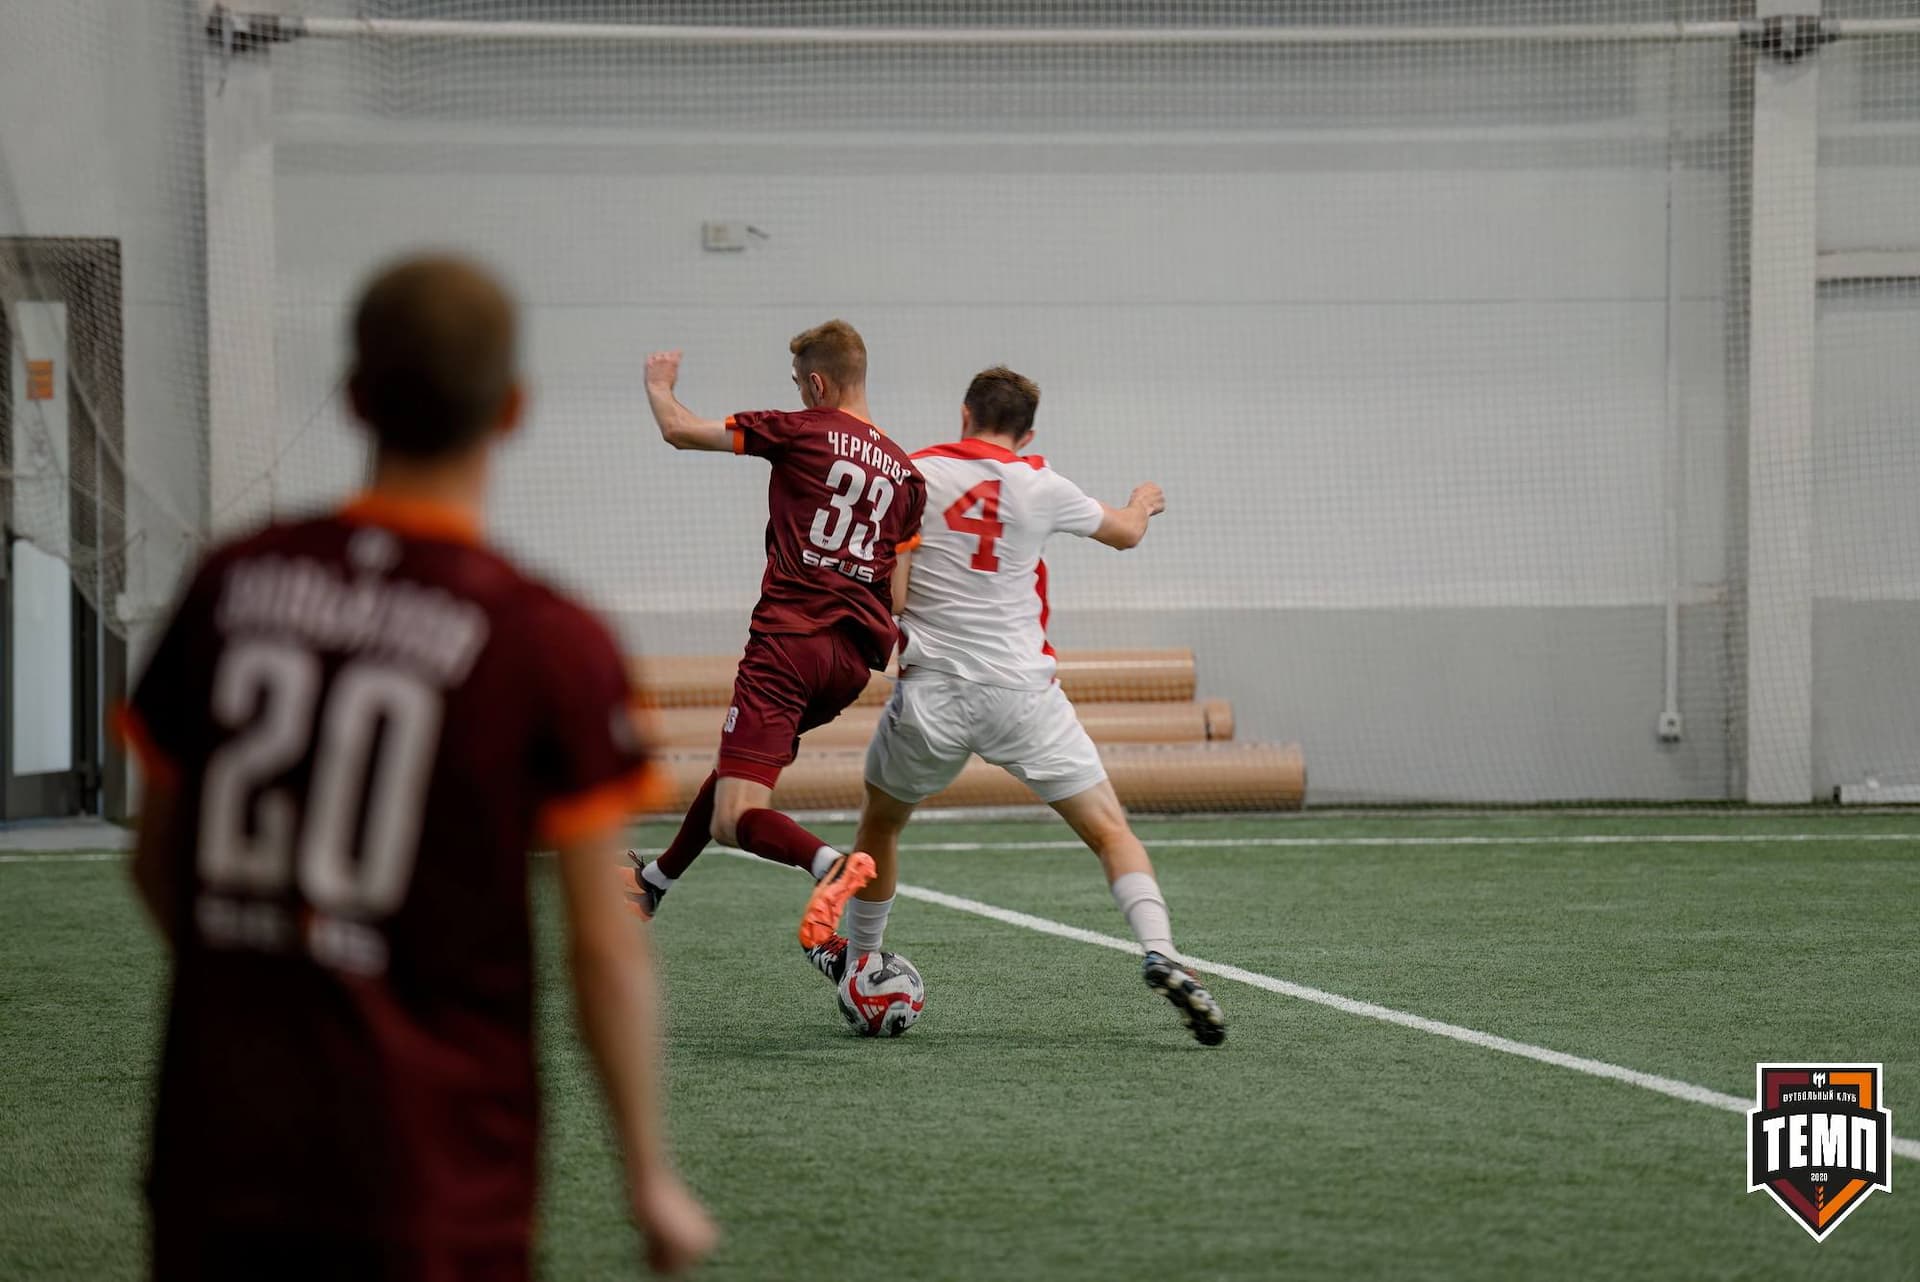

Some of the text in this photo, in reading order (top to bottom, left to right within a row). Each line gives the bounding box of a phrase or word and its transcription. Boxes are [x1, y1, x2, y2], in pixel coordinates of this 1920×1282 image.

[809, 460, 894, 561] 33
[943, 480, 1003, 573] 4
[197, 642, 444, 917] 20
